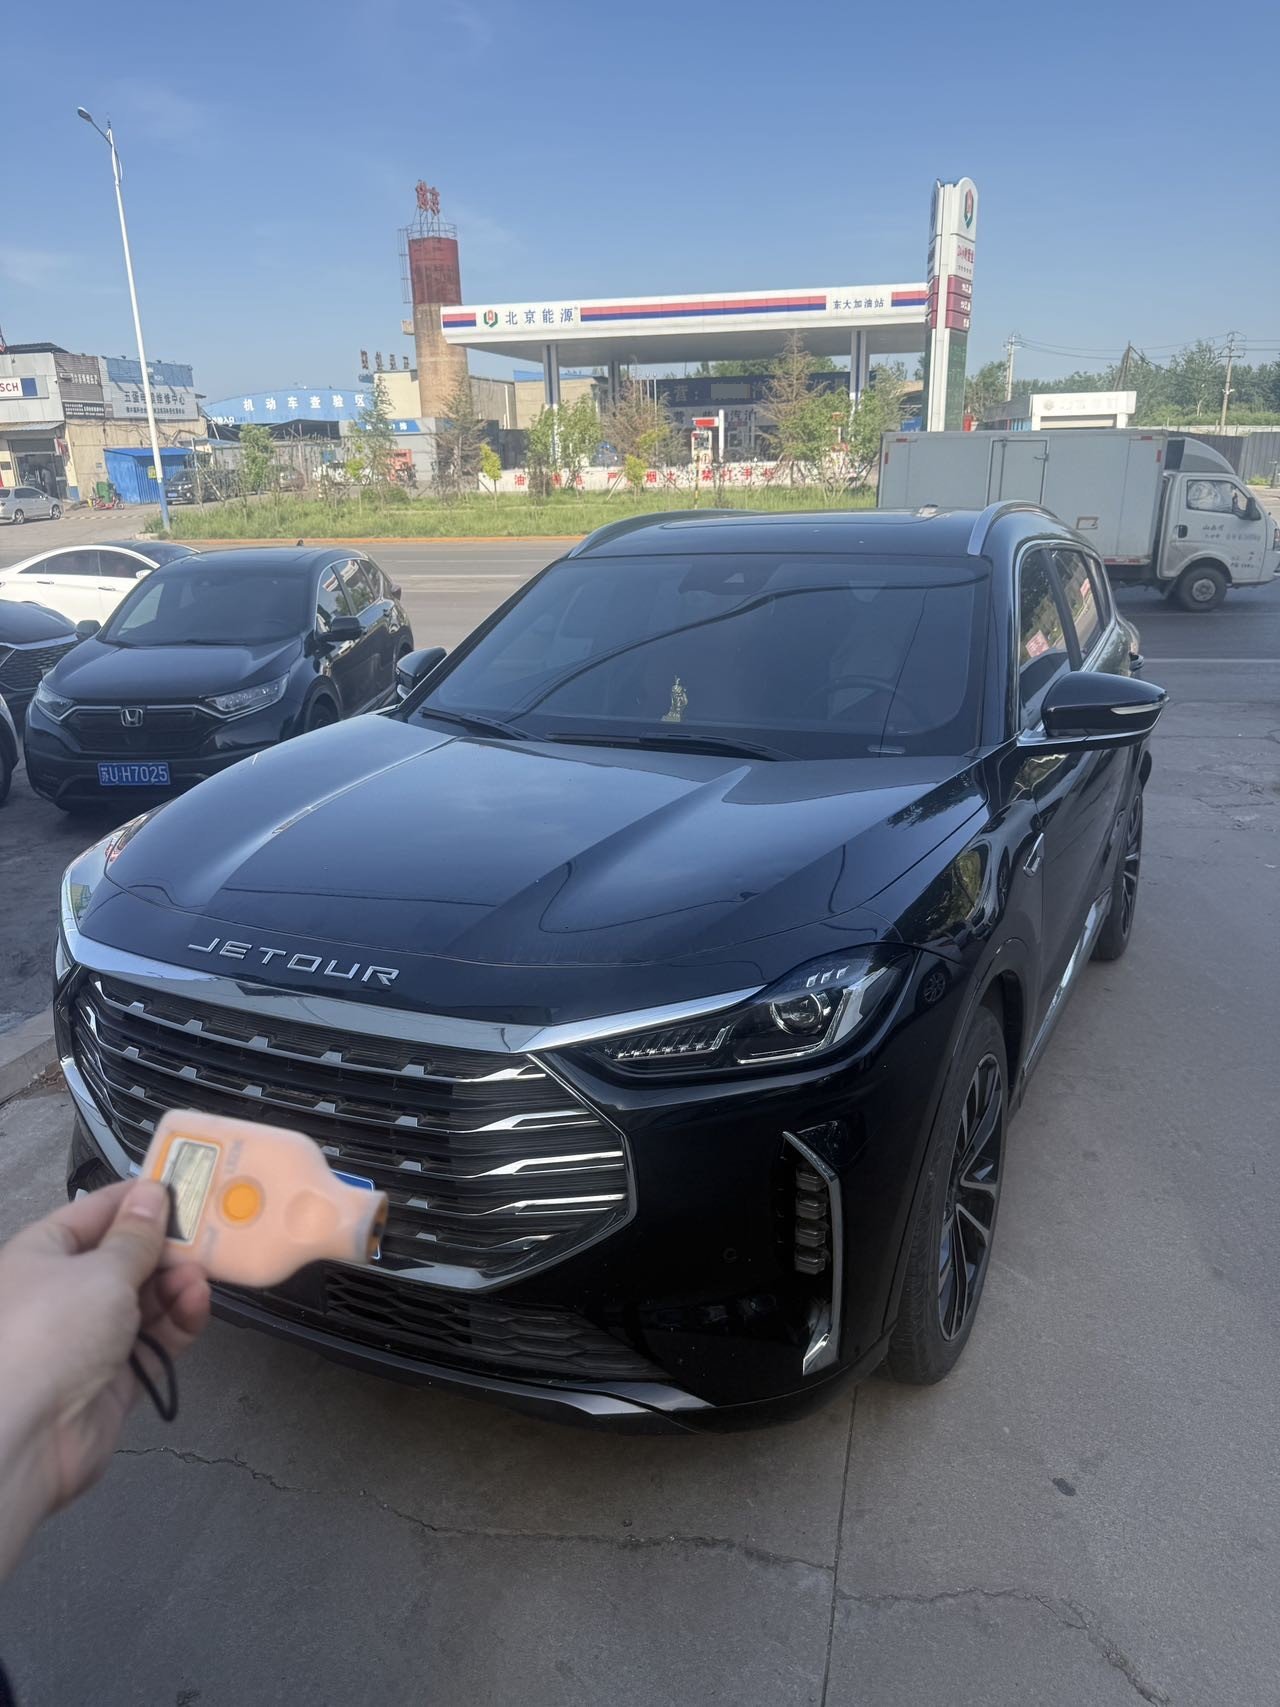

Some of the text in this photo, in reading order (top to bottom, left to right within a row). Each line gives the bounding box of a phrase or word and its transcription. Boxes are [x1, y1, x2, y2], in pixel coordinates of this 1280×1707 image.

[832, 297, 885, 310] 东大加油站
[505, 308, 574, 325] 北京能源
[242, 394, 366, 412] 机动车查验区
[187, 937, 402, 987] JETOUR
